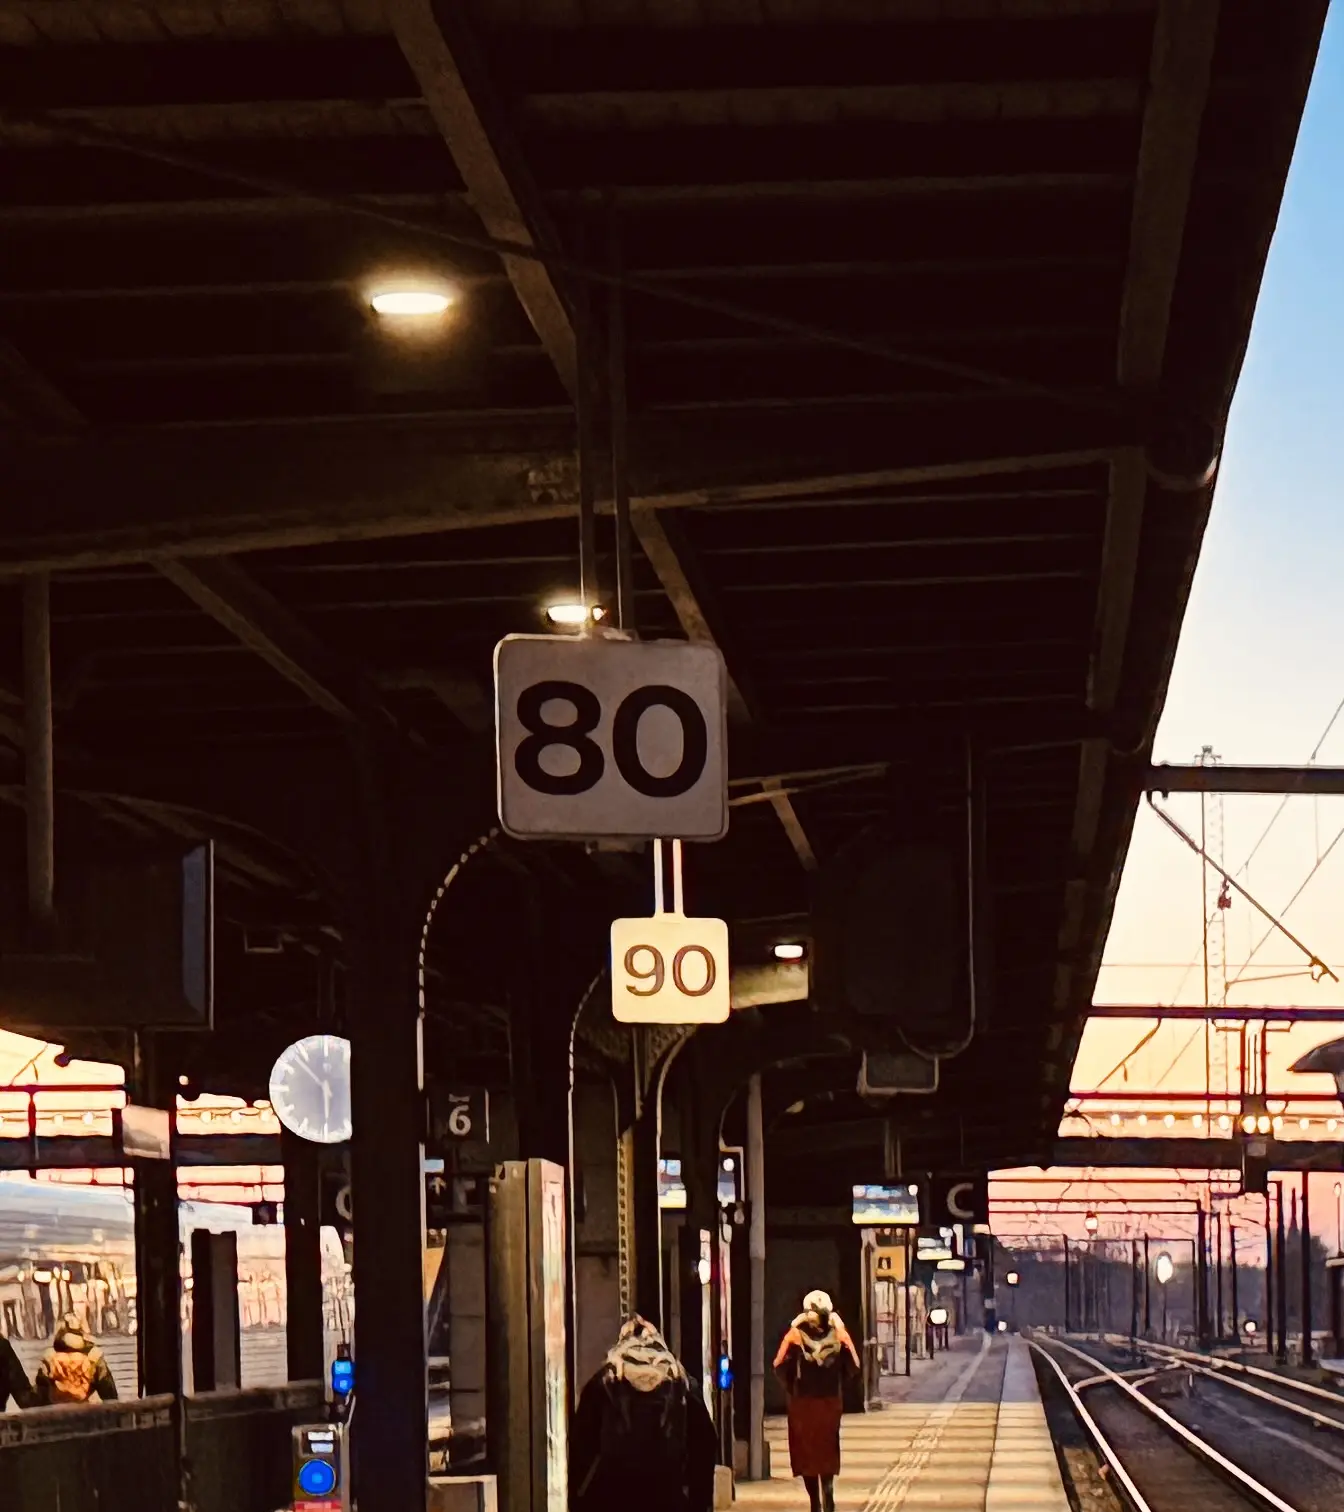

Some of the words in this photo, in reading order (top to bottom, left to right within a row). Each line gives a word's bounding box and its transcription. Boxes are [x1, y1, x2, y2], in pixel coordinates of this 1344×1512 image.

[514, 679, 708, 799] 80
[622, 943, 717, 998] 90
[448, 1104, 472, 1136] 6
[946, 1182, 974, 1219] C
